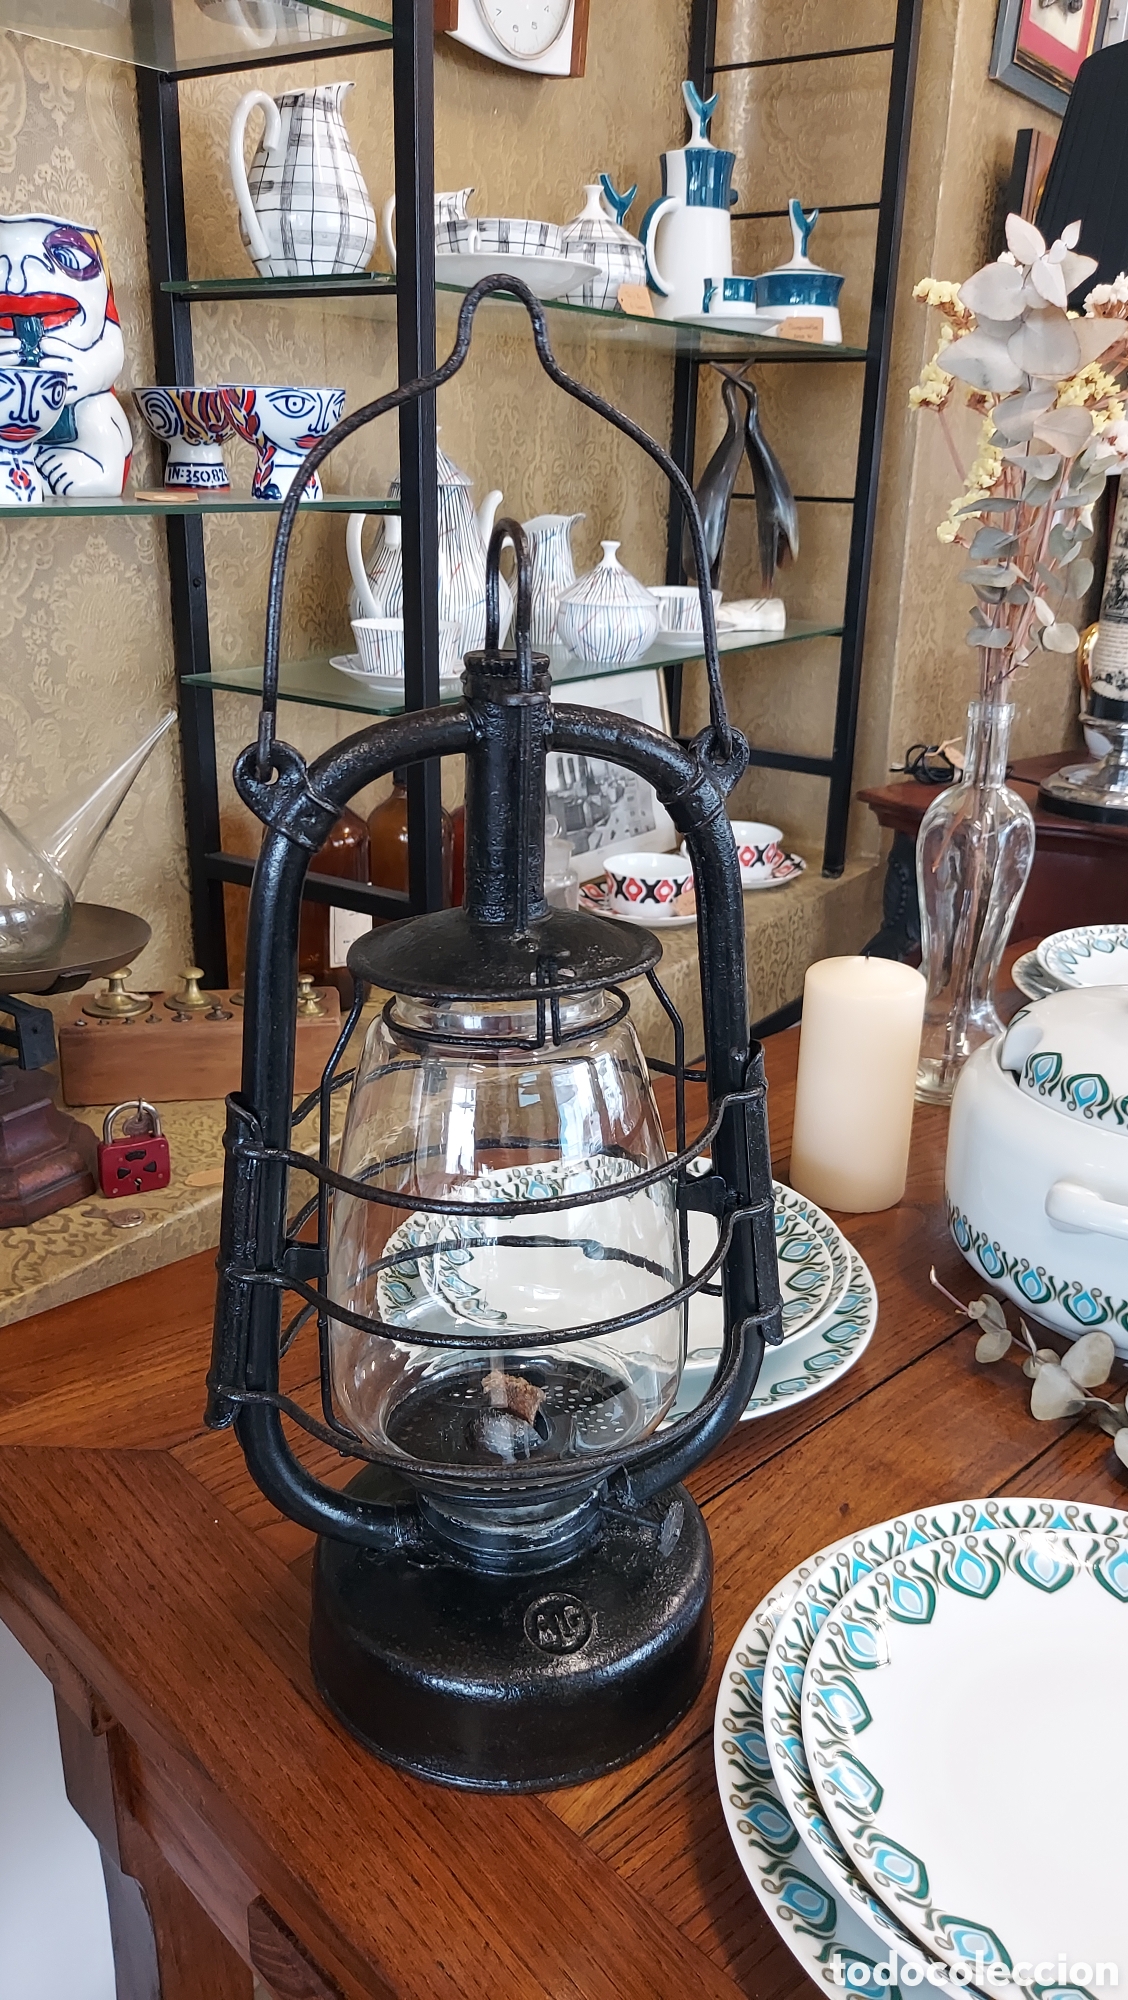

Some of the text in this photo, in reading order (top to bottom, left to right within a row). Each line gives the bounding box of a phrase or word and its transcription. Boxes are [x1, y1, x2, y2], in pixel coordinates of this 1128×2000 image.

[495, 8, 502, 16] 7
[512, 24, 519, 33] 6
[531, 21, 538, 30] 5
